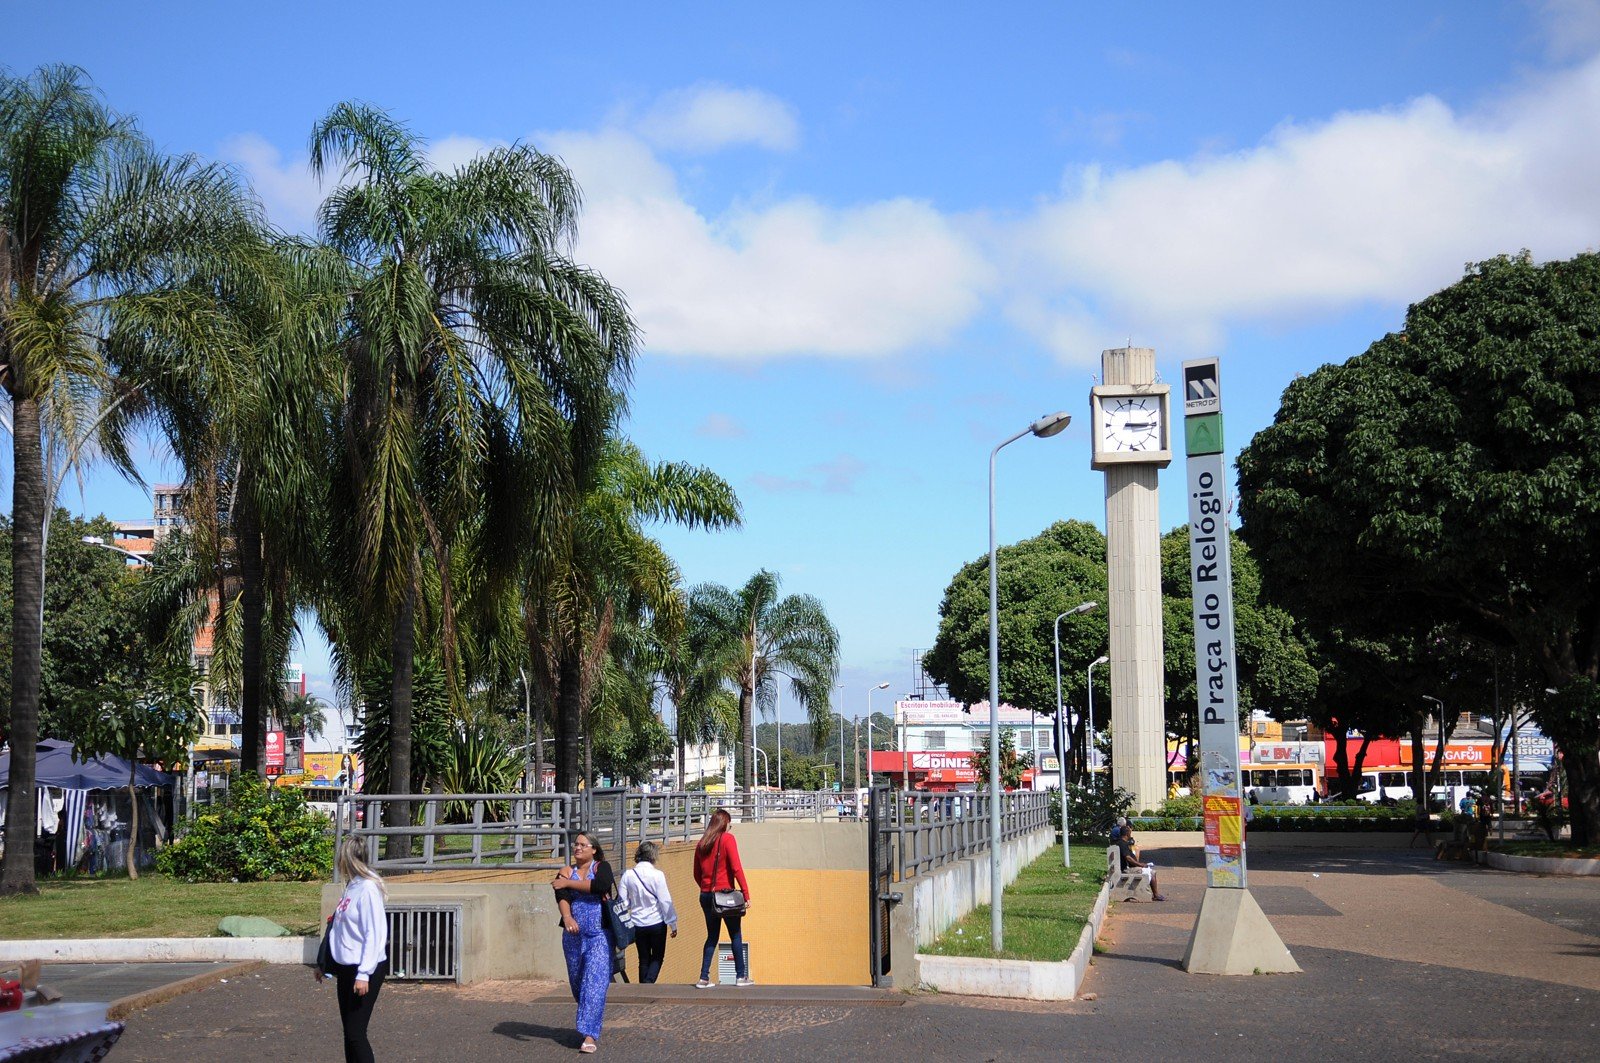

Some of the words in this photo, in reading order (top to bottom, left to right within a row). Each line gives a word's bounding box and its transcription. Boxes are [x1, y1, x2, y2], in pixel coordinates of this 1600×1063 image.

[1193, 471, 1221, 582] Relógio
[1199, 593, 1221, 630] do
[1204, 640, 1228, 725] Praça
[930, 757, 971, 768] DINIZ
[1273, 747, 1293, 759] BV
